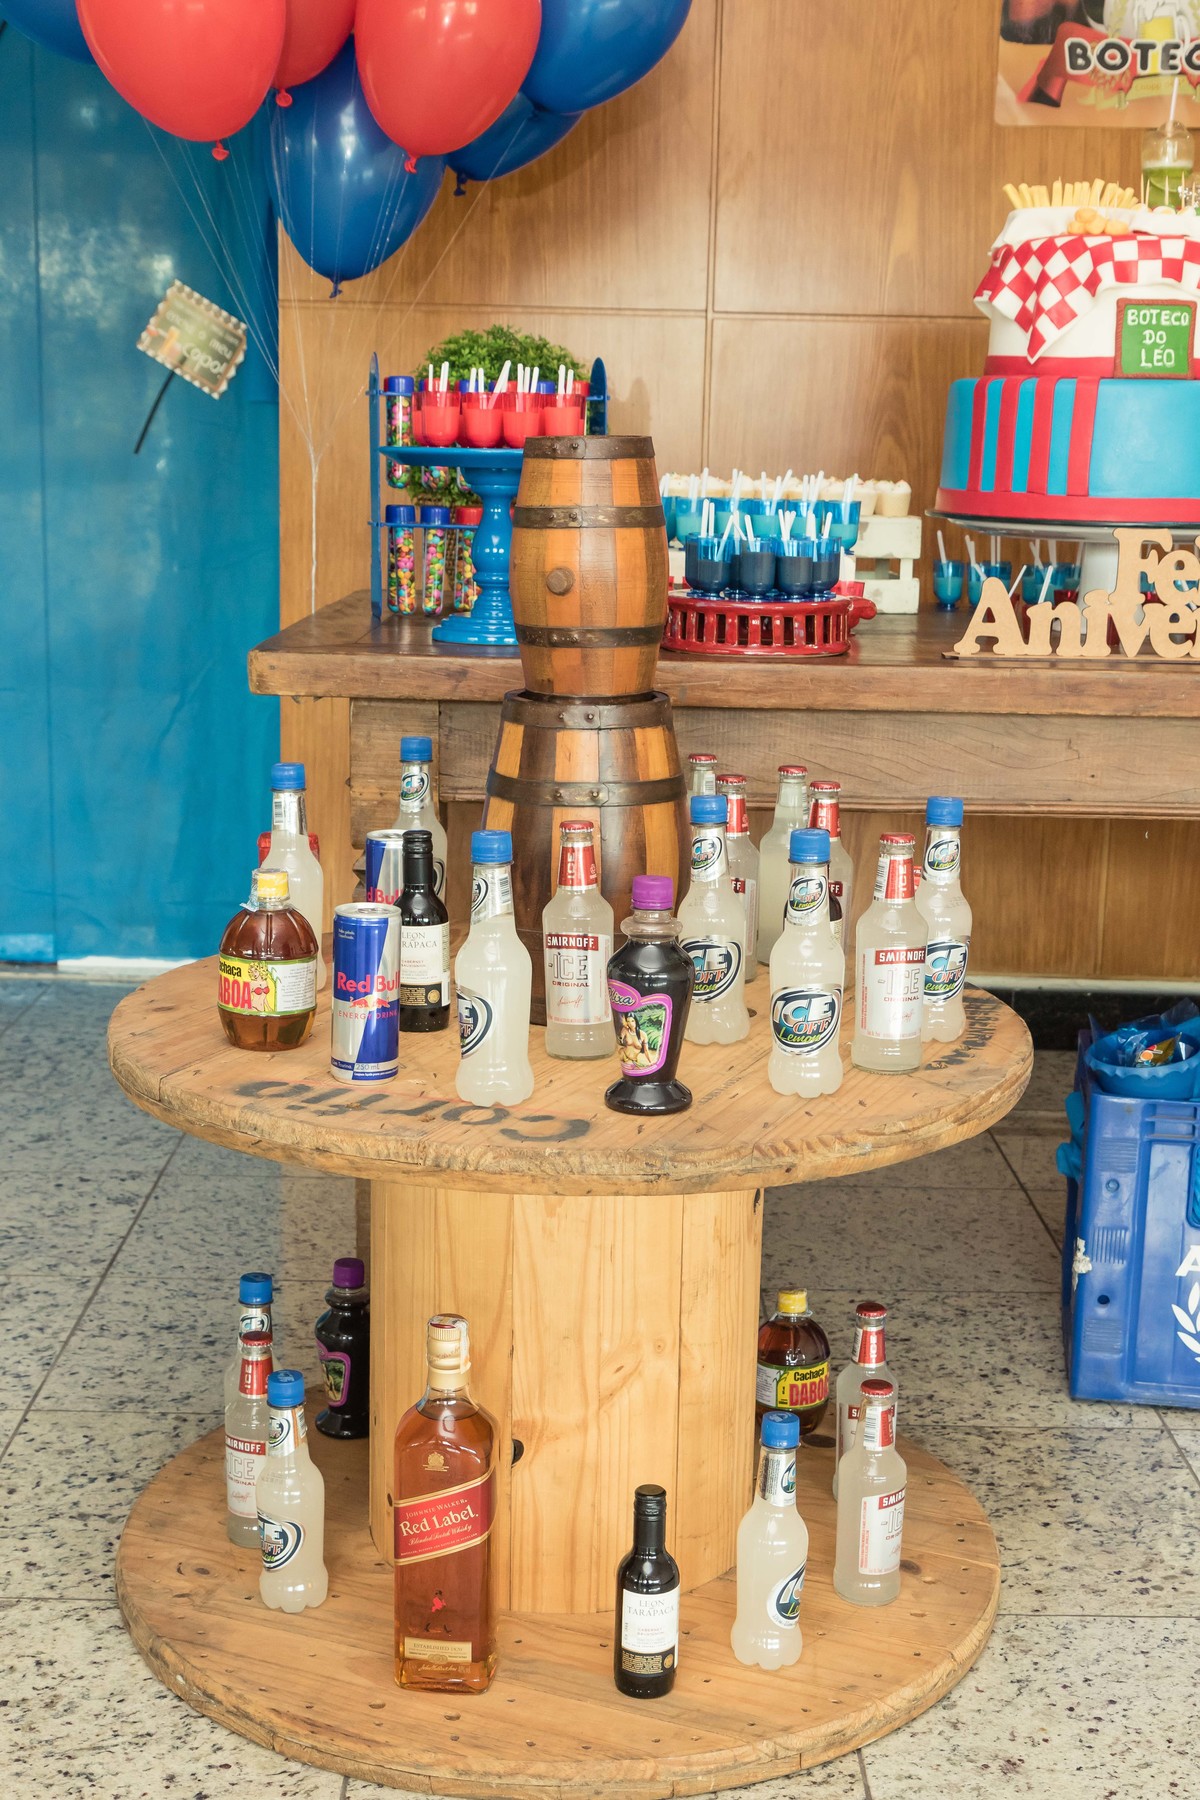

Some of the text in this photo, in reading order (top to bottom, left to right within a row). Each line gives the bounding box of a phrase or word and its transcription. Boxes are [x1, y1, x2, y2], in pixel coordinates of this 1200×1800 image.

[1127, 308, 1190, 326] BOTECO
[1142, 329, 1167, 345] DO
[1140, 344, 1175, 368] LÉO
[1110, 527, 1200, 608] Fe
[953, 576, 1200, 659] Anive
[376, 886, 404, 905] Bul
[402, 941, 438, 950] RAPACA
[547, 935, 595, 948] SMIRNOFF
[879, 949, 925, 963] SMIRNOFF
[927, 949, 966, 976] CE
[553, 953, 588, 981] ICE
[337, 972, 370, 993] Red
[375, 973, 400, 993] Bull
[924, 980, 956, 992] emon
[218, 976, 252, 1009] ABOA
[338, 1010, 398, 1020] ENERGY DRINK
[773, 995, 832, 1027] ICE
[779, 1026, 821, 1042] Lemon
[793, 1019, 832, 1034] OFF
[794, 1367, 825, 1382] Cachaça
[399, 1504, 479, 1537] Red Label.
[406, 1506, 435, 1520] JOHNNIE
[413, 1643, 450, 1651] ESTABLISHED
